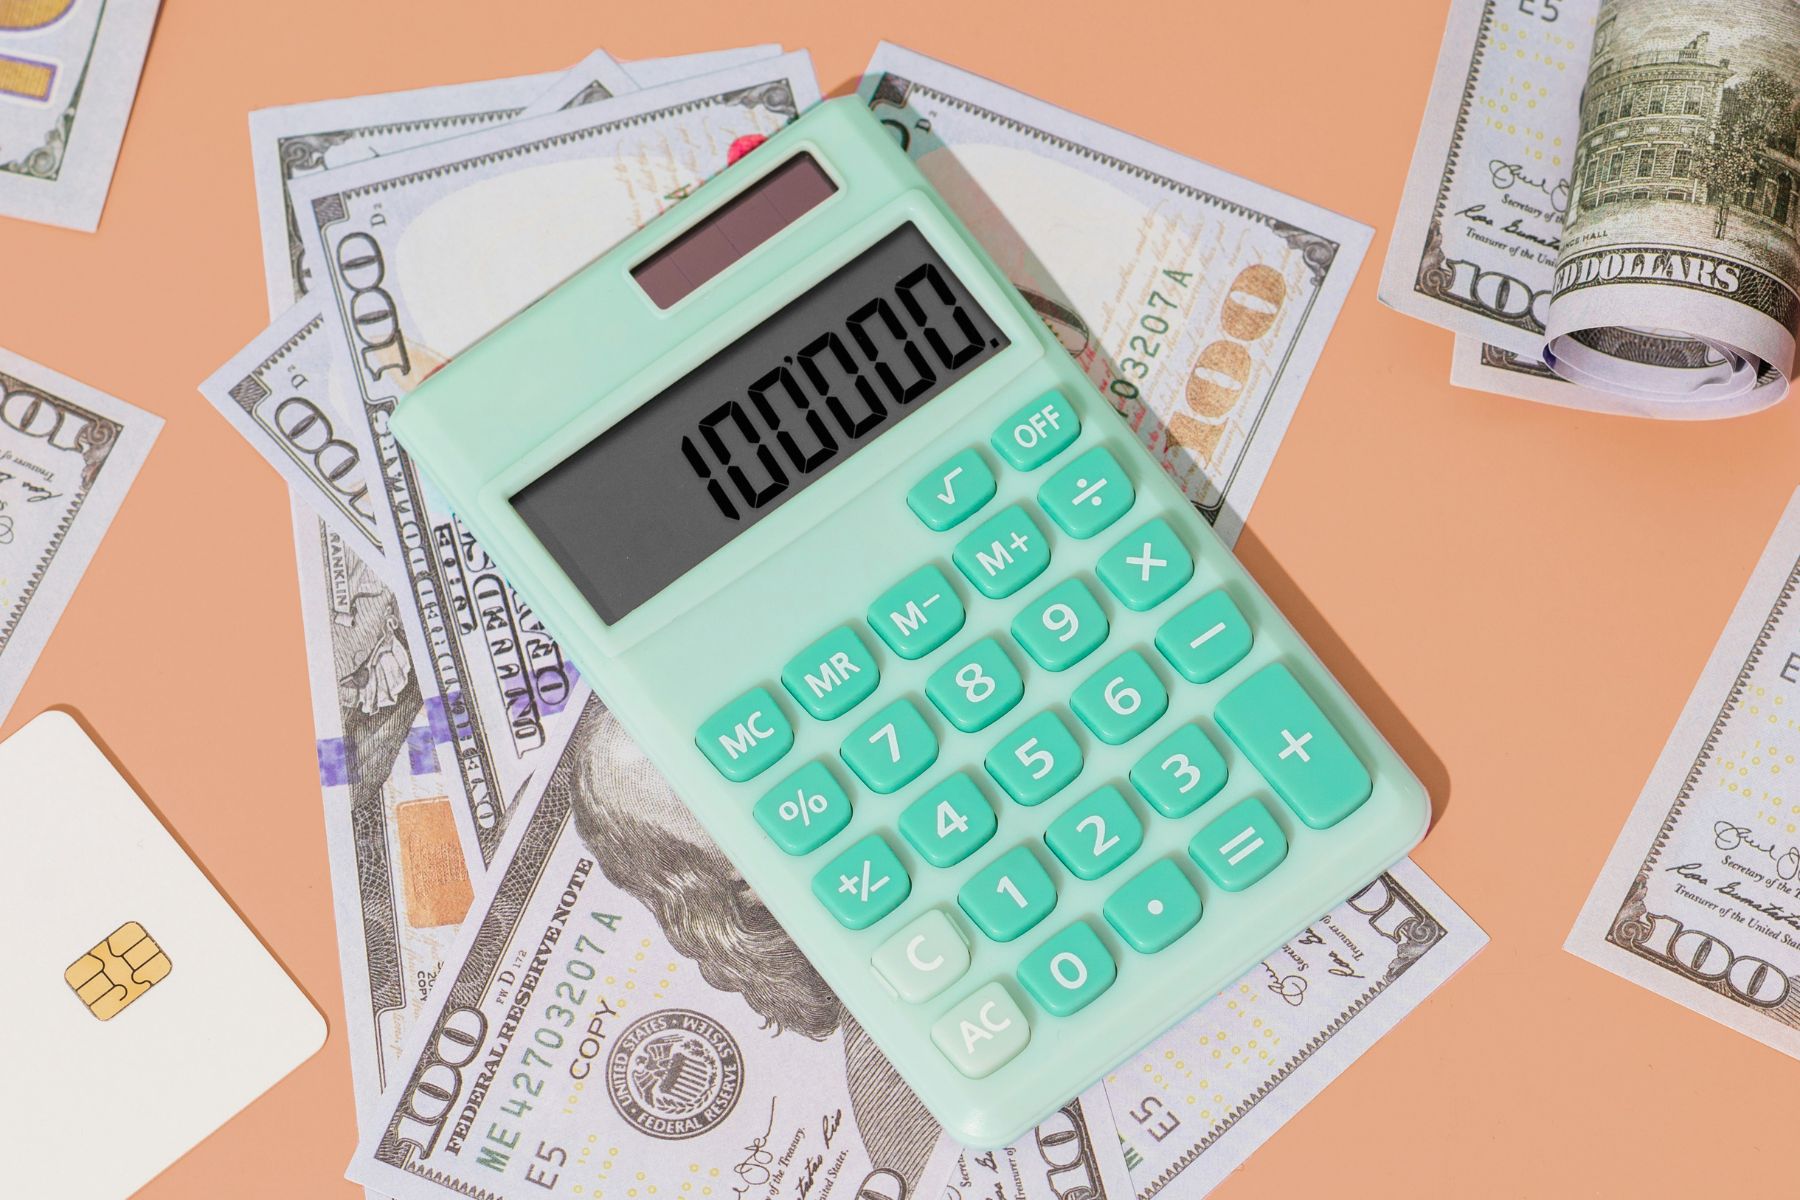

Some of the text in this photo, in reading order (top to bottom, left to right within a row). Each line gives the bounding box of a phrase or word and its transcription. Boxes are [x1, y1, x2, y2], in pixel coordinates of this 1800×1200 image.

[1578, 252, 1740, 295] DOLLARS
[336, 231, 411, 383] 100
[1166, 263, 1287, 468] 100
[1013, 404, 1060, 449] OFF
[329, 530, 349, 608] RANKLIN
[975, 531, 1029, 577] M+
[1042, 603, 1079, 642] 9
[803, 651, 861, 699] MR
[955, 662, 996, 703] 8
[1104, 676, 1142, 716] 6
[718, 711, 775, 760] MC
[868, 722, 901, 763] 7
[1014, 737, 1055, 780] 5
[1161, 753, 1201, 794] 3
[778, 788, 828, 827] %
[936, 800, 969, 839] 4
[1076, 815, 1121, 857] 2
[1721, 854, 1765, 883] Secretary
[996, 875, 1029, 909] 1
[1674, 883, 1719, 911] Treasurer
[1747, 917, 1782, 941] United
[905, 934, 945, 972] C
[1049, 951, 1088, 990] 0
[1645, 911, 1791, 1009] 100
[445, 857, 594, 1156] FEDERAL RESERVE NOTE
[958, 1000, 1012, 1054] AC
[569, 999, 618, 1080] COPY
[611, 1016, 668, 1107] UNITED STATES
[396, 1005, 489, 1161] 100
[636, 1016, 737, 1134] FEDERAL RESERVE SYSTEM
[524, 1140, 568, 1191] E5
[778, 1127, 806, 1168] Treasury.
[827, 1149, 849, 1178] States.
